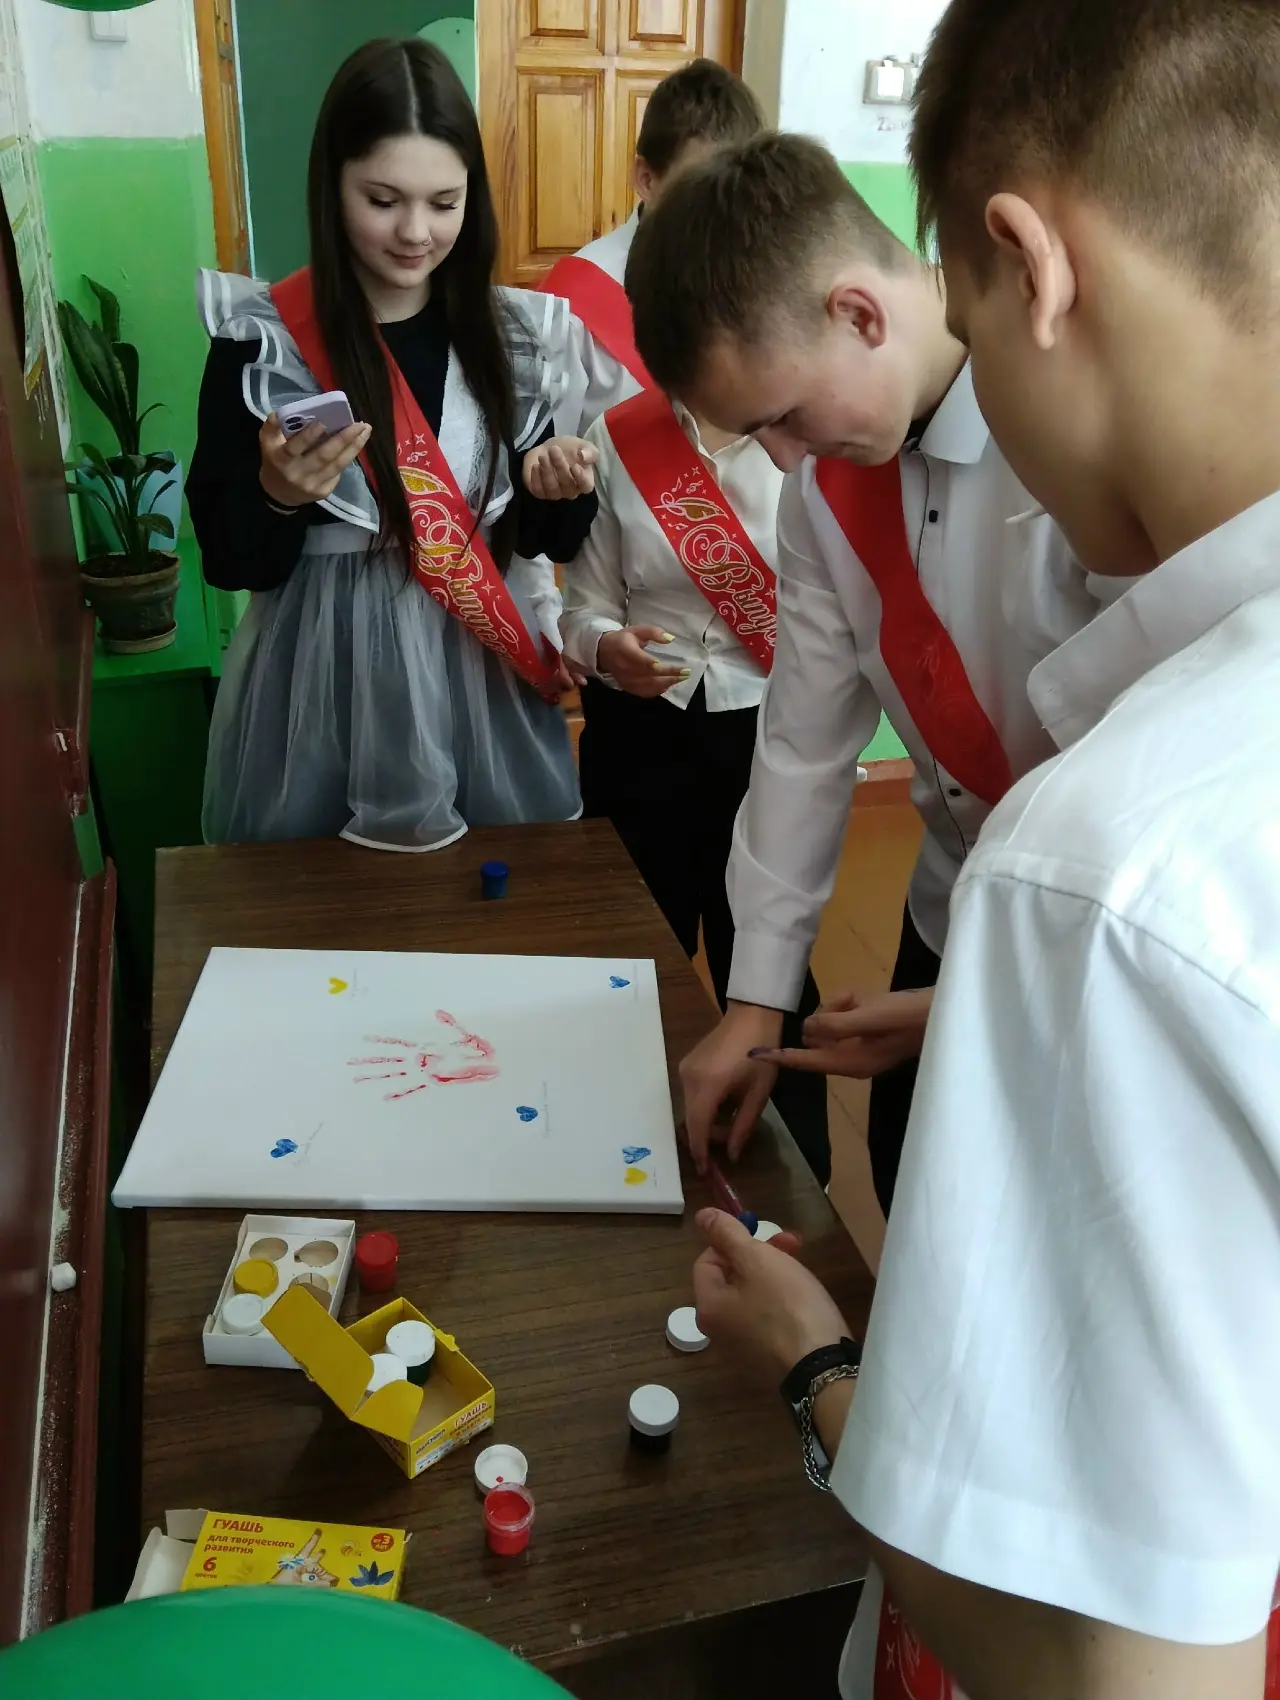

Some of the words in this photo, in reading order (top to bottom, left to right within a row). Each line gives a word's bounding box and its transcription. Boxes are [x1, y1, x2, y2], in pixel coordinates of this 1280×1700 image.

[455, 1402, 488, 1428] ГУАШЬ
[213, 1519, 264, 1533] ГУАШЬ
[207, 1534, 228, 1543] для
[230, 1536, 295, 1549] творческого
[382, 1534, 391, 1545] 3
[204, 1543, 254, 1554] развития
[203, 1557, 218, 1572] 6
